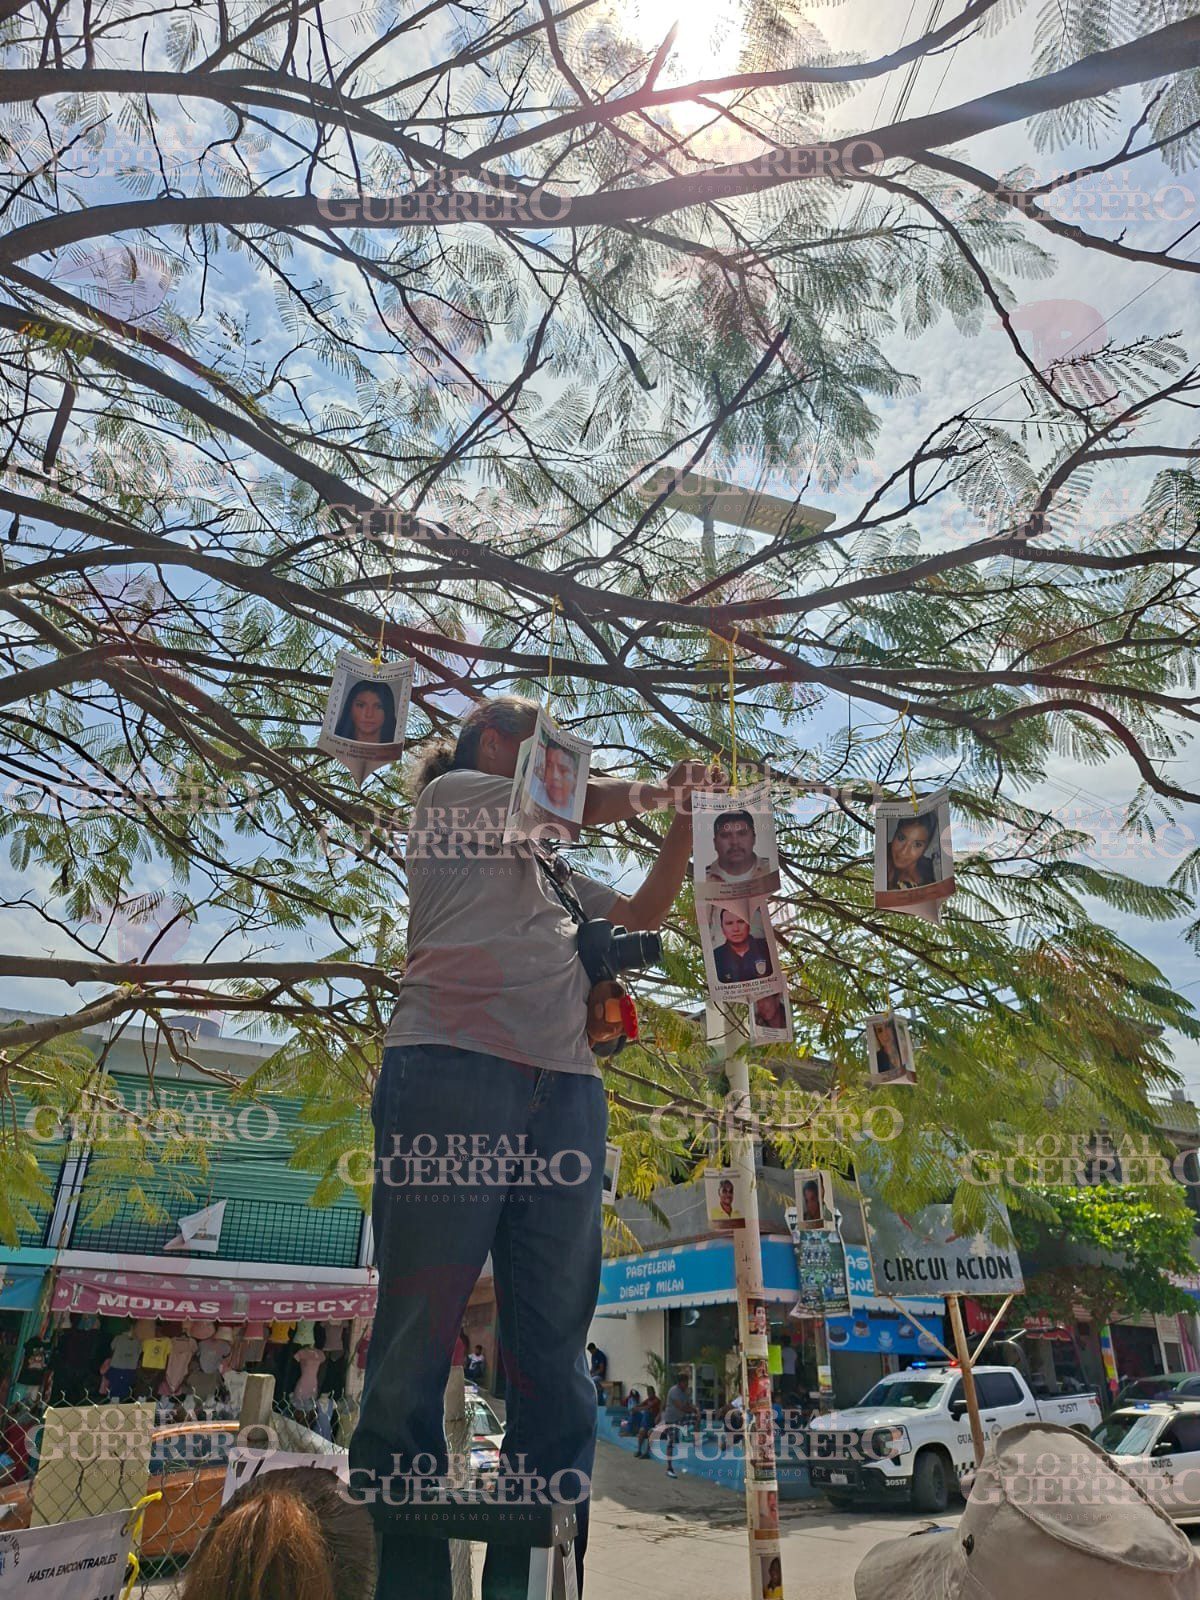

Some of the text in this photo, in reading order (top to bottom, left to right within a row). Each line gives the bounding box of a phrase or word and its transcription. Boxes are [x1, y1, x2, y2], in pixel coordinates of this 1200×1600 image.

[626, 1259, 676, 1279] PASTELERIA
[620, 1278, 685, 1299] DISNEY MILAN
[97, 1293, 220, 1314] MODAS
[27, 1552, 118, 1583] HASTA ENCONTRARLES
